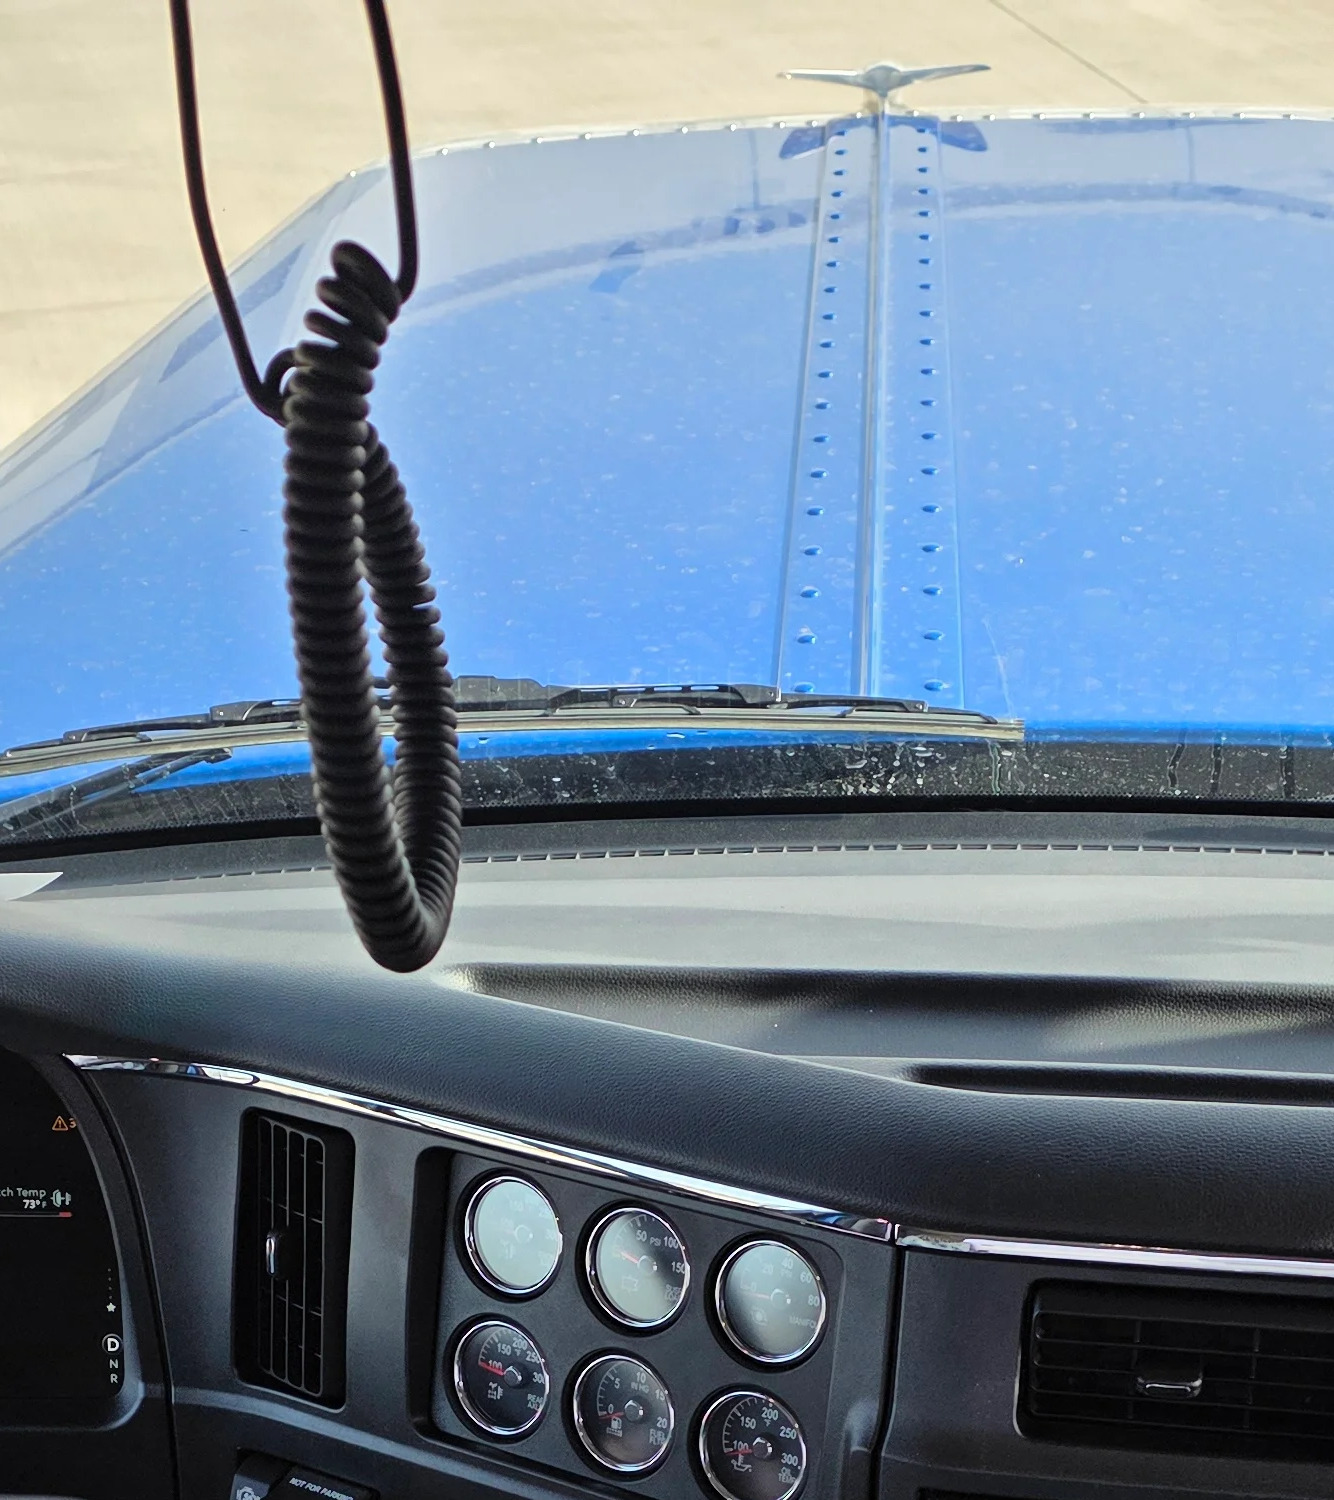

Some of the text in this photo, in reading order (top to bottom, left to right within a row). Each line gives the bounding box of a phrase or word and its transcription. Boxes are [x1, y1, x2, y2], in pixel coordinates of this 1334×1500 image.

[16, 1188, 46, 1199] Temp
[636, 1229, 647, 1241] 50
[664, 1236, 678, 1249] 100
[800, 1271, 812, 1283] 60
[808, 1294, 820, 1306] 80
[107, 1338, 120, 1351] D
[497, 1343, 511, 1356] 150
[512, 1337, 527, 1350] 200
[110, 1359, 119, 1369] N
[110, 1374, 118, 1383] R
[614, 1377, 621, 1389] 5
[636, 1371, 646, 1384] 10
[655, 1389, 665, 1401] 15
[608, 1403, 614, 1414] 0
[761, 1407, 778, 1420] 200
[656, 1416, 667, 1429] 20
[740, 1416, 757, 1429] 150
[649, 1429, 665, 1438] FUEL
[779, 1426, 796, 1439] 250
[733, 1440, 749, 1451] 100
[781, 1452, 798, 1466] 300
[780, 1467, 792, 1476] OIL
[289, 1478, 307, 1488] NOT
[305, 1483, 321, 1493] FOR
